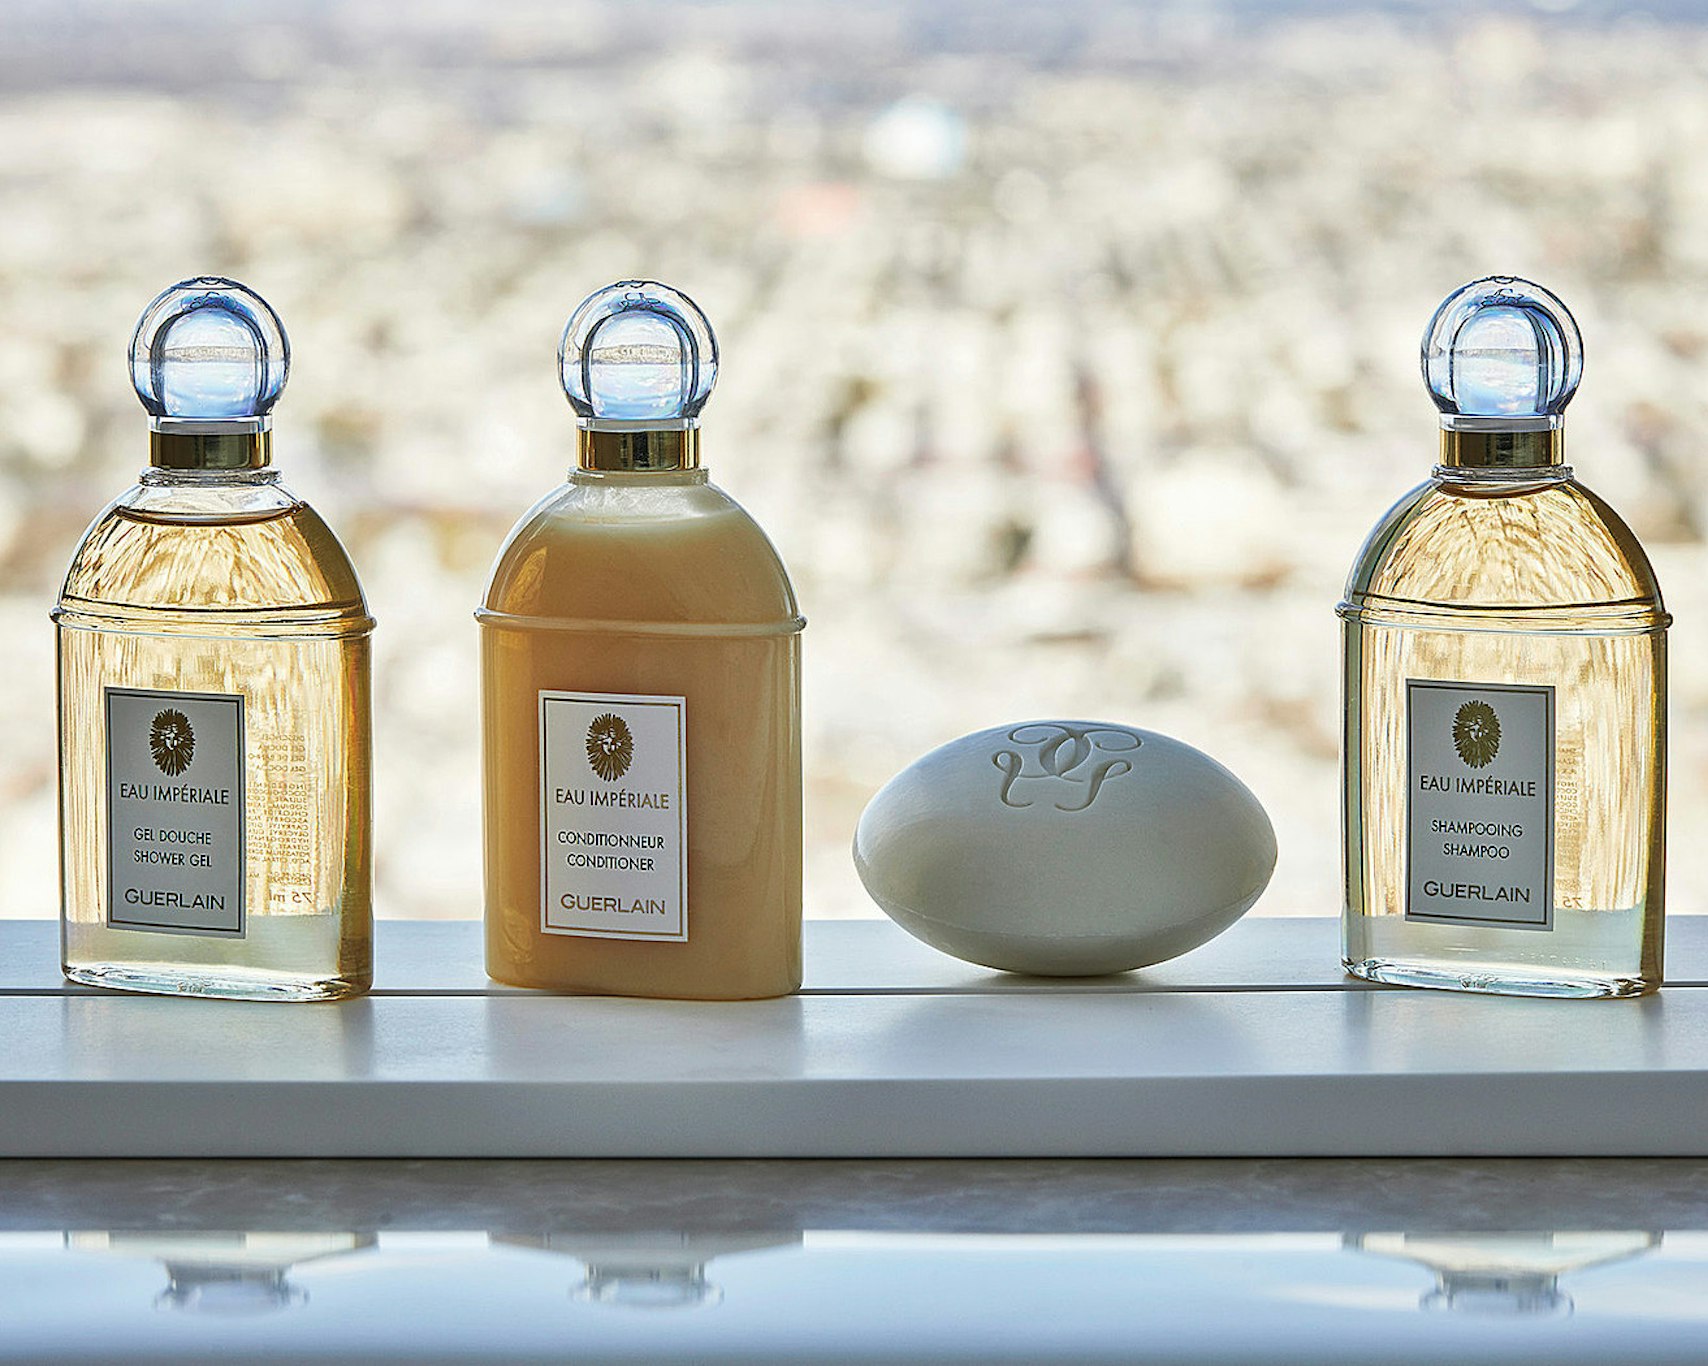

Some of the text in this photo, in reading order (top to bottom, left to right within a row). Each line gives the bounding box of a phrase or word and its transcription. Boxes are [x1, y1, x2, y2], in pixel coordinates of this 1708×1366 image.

[121, 783, 148, 800] EAU
[153, 783, 229, 805] IMPÉRIALE
[1420, 775, 1536, 797] EAU IMPÉRIALE
[556, 788, 669, 809] EAU IMPÉRIALE
[134, 828, 211, 845] GEL DOUCHE
[1431, 819, 1523, 838] SHAMPOOING
[558, 831, 664, 849] CONDITIONNEUR
[134, 850, 212, 867] SHOWER GEL
[1443, 843, 1510, 859] SHAMPOO
[567, 854, 654, 871] CONDITIONER
[124, 888, 225, 910] GUERLAIN
[1423, 880, 1530, 903] GUERLAIN
[560, 893, 665, 915] GUERLAIN
